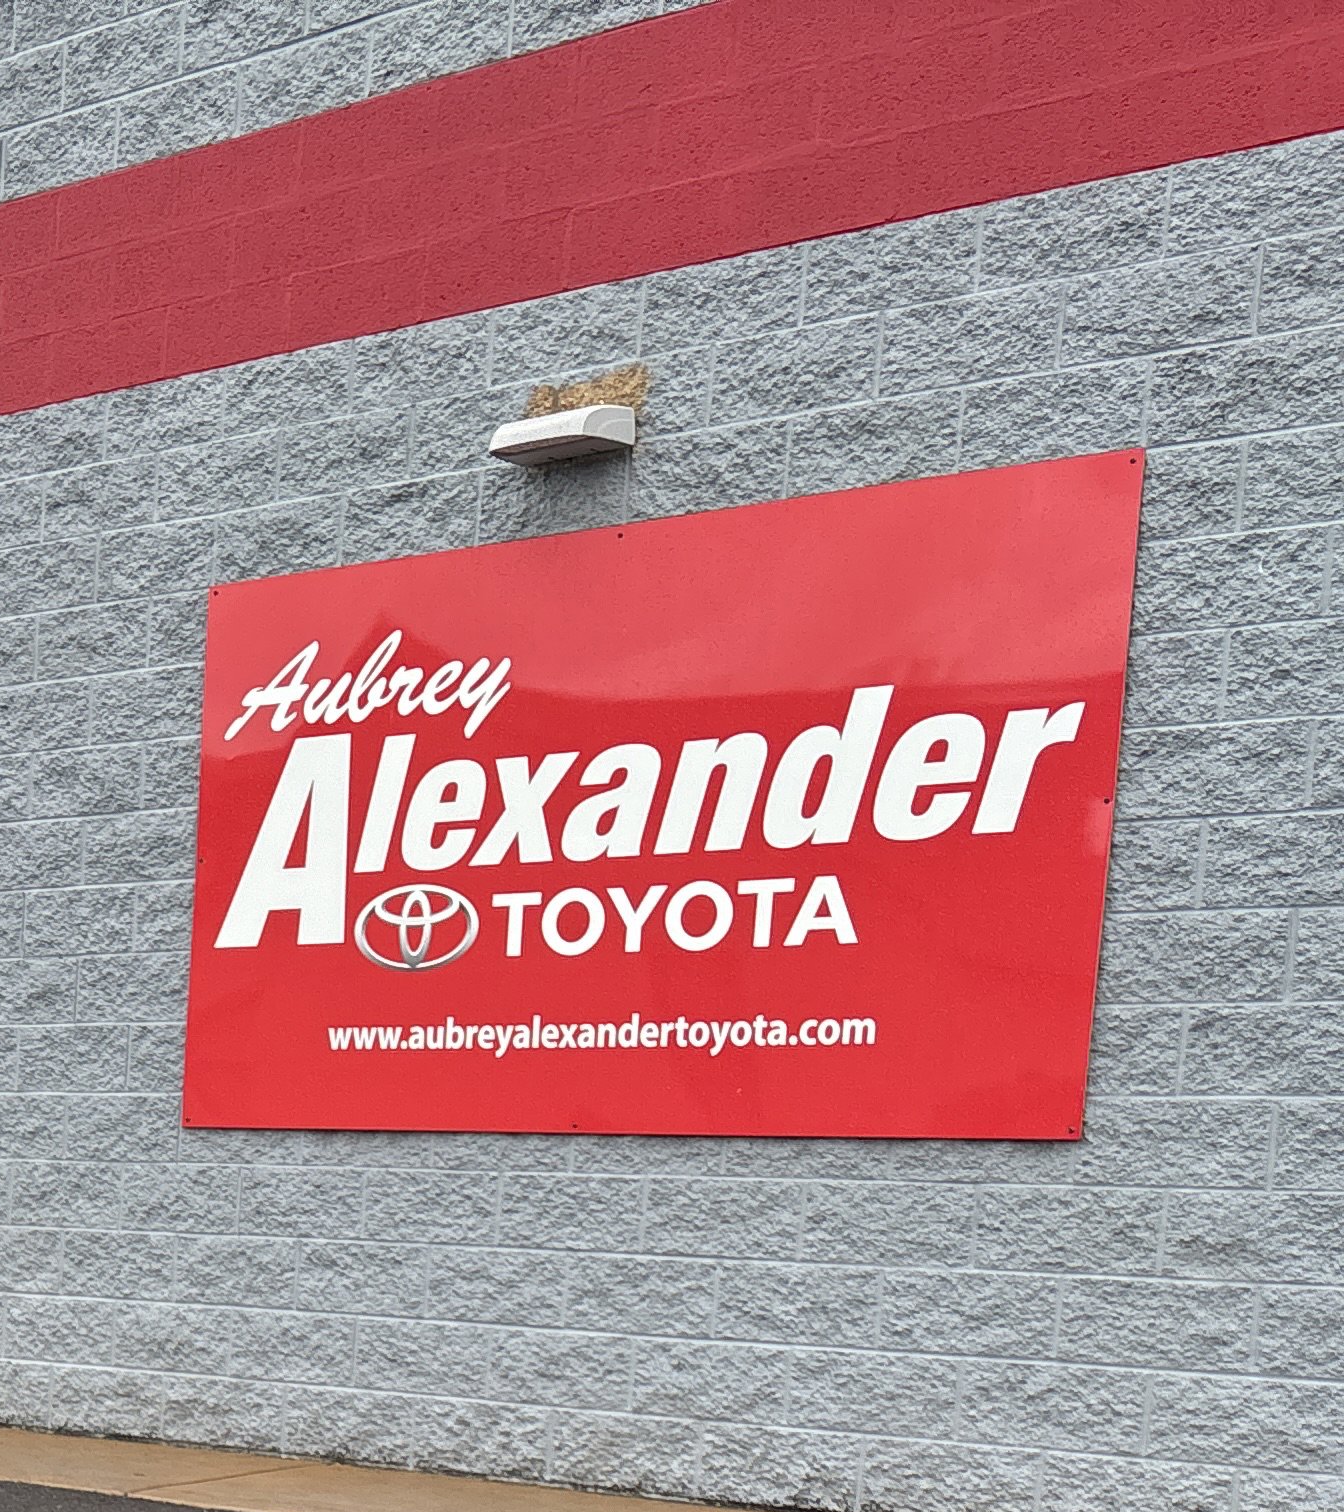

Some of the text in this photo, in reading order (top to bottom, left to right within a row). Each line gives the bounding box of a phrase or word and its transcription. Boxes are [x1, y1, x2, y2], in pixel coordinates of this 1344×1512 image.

[223, 629, 512, 741] Aubrey
[213, 684, 1086, 949] Alexander
[491, 875, 859, 958] TOYOTA
[327, 1012, 877, 1058] www.aubreyalexandertoyota.com
